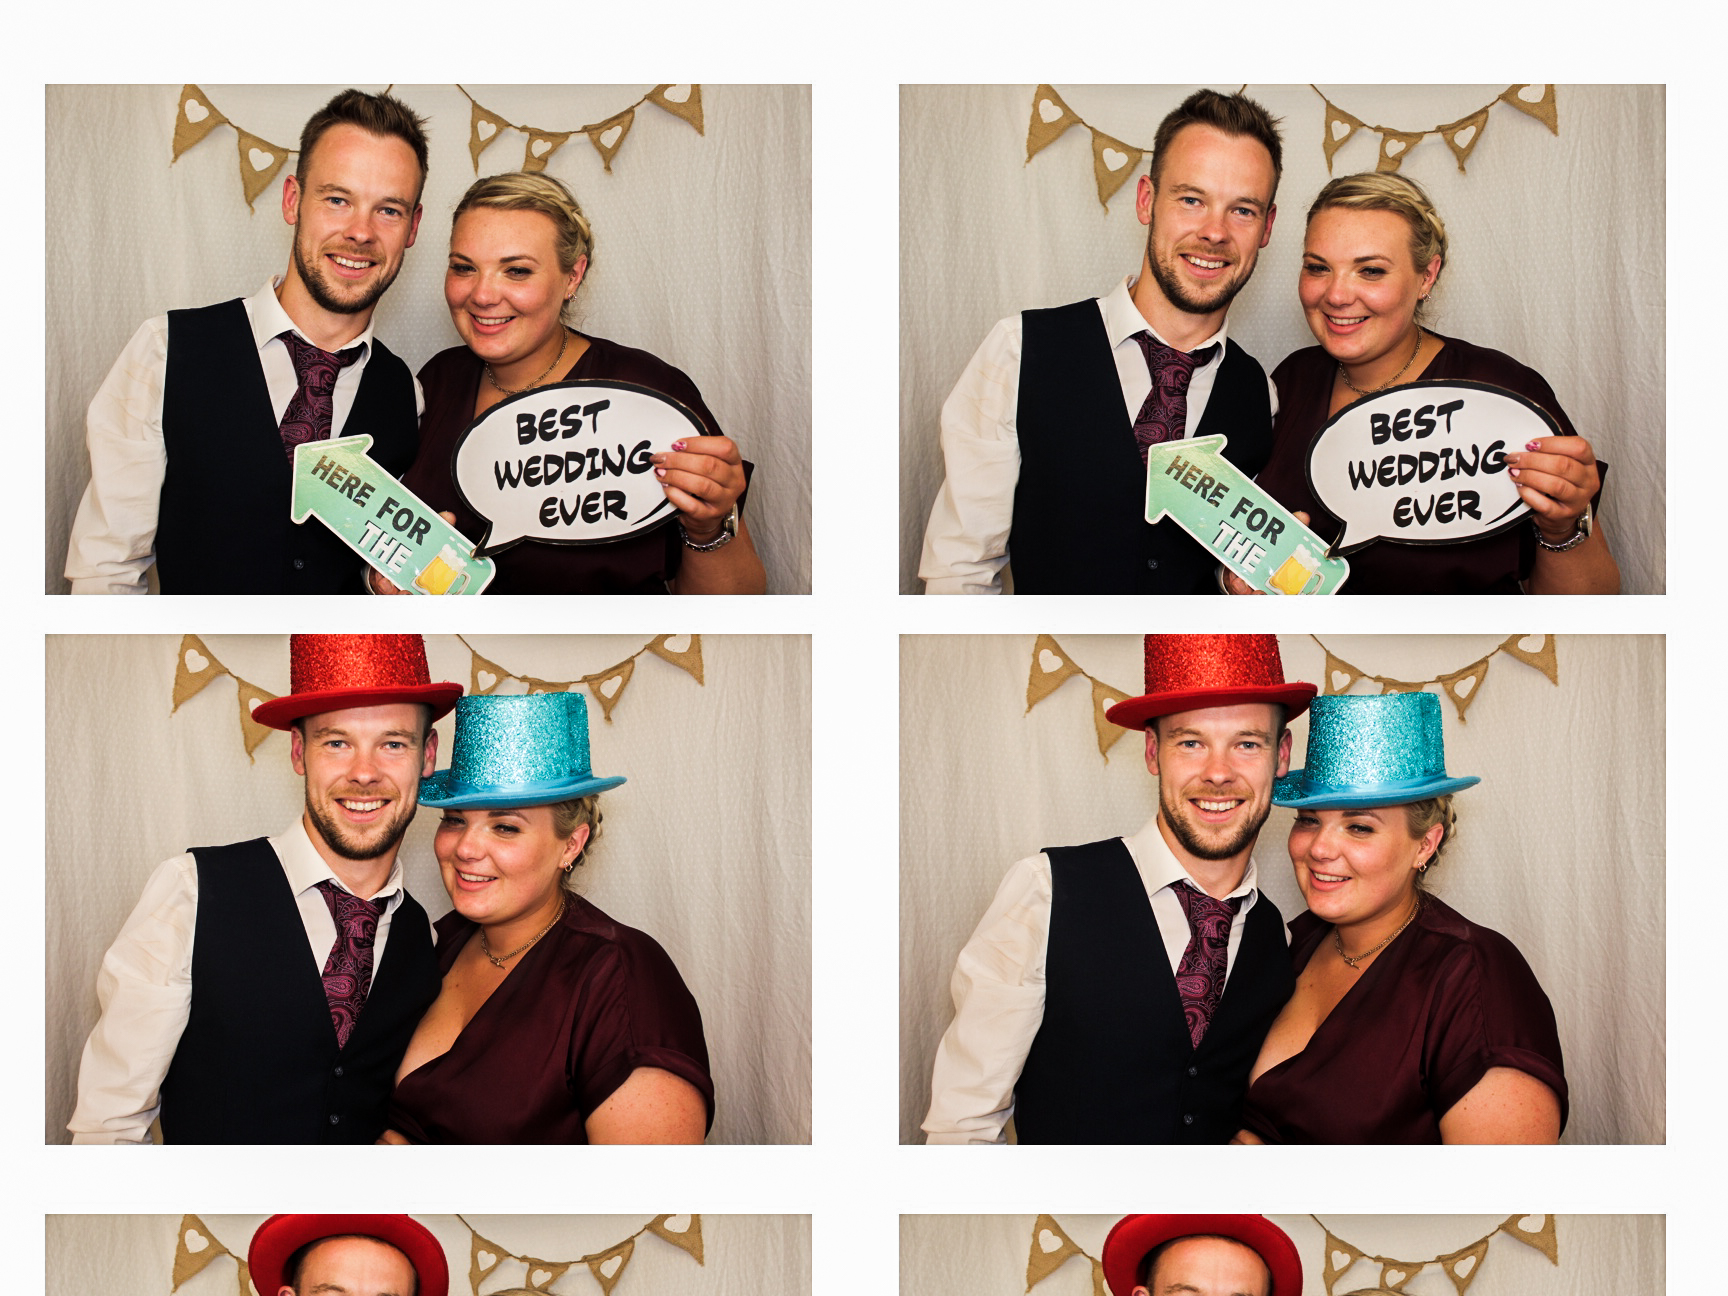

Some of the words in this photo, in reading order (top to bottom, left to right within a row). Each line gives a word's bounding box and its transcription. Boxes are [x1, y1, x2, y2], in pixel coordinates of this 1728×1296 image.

[516, 399, 611, 445] BEST
[1370, 399, 1465, 445] BEST
[494, 440, 655, 491] WEDDING
[1348, 440, 1509, 491] WEDDING
[311, 455, 376, 508] HERE
[375, 496, 432, 546] FOR
[539, 490, 628, 528] EVER
[1165, 455, 1230, 508] HERE
[1229, 496, 1286, 546] FOR
[1393, 490, 1482, 528] EVER
[358, 520, 413, 574] THE
[1212, 520, 1267, 574] THE
